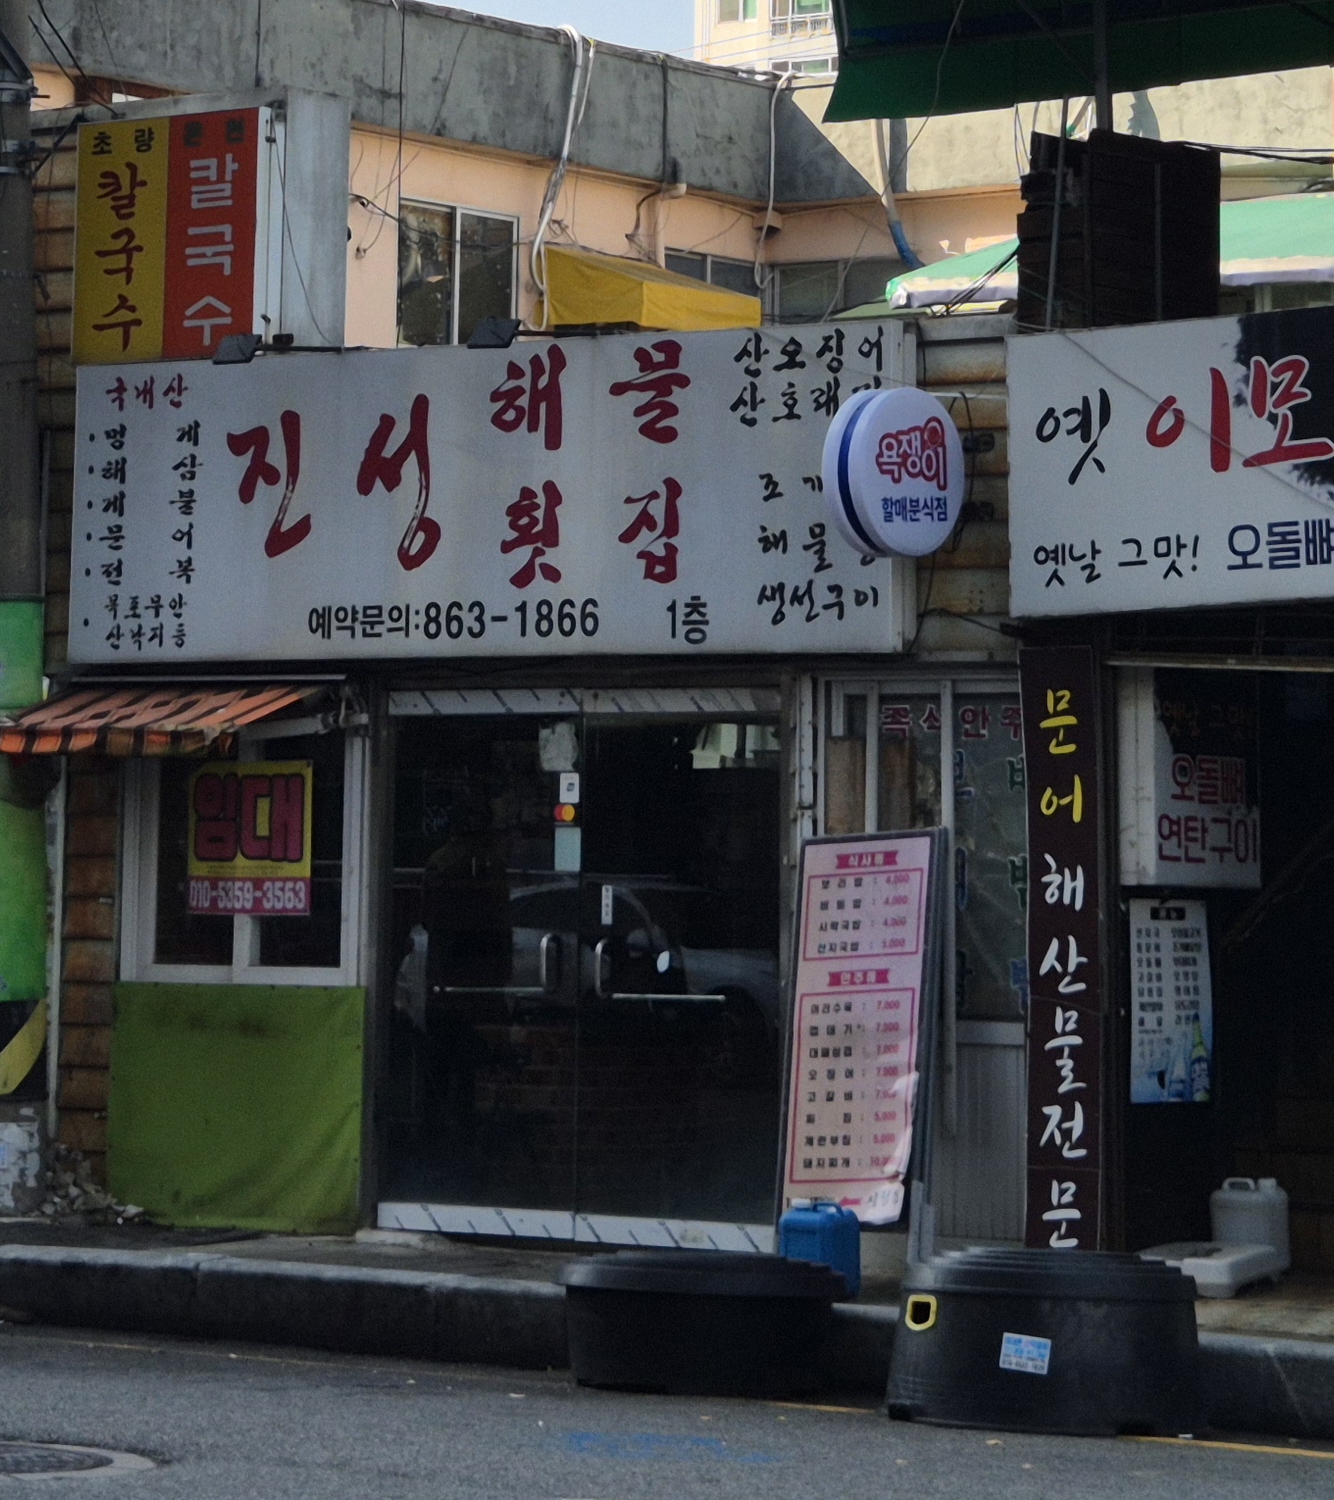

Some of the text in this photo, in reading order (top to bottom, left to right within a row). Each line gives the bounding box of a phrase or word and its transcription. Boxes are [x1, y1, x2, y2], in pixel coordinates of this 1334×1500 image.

[91, 127, 155, 156] 초량
[91, 161, 148, 352] 칼국수
[182, 152, 239, 346] 칼국수
[732, 326, 884, 378] 산오징어
[105, 373, 189, 411] 국내산
[489, 339, 691, 451] 해물
[728, 375, 883, 428] 산호래
[104, 420, 202, 451] 멍게
[876, 416, 948, 491] 욕쟁이
[1035, 387, 1111, 486] 옛
[101, 456, 204, 486] 해삼
[226, 393, 442, 572] 진성
[500, 477, 683, 589] 횟집
[880, 496, 949, 523] 할매분식점
[99, 522, 195, 552] 문어
[1032, 538, 1102, 588] 옛날
[100, 557, 196, 587] 전복
[666, 595, 710, 645] 1층
[756, 580, 880, 626] 생선구이
[1039, 688, 1083, 824] 문어
[193, 772, 305, 862] 임대
[1157, 813, 1257, 865] 연탄구이
